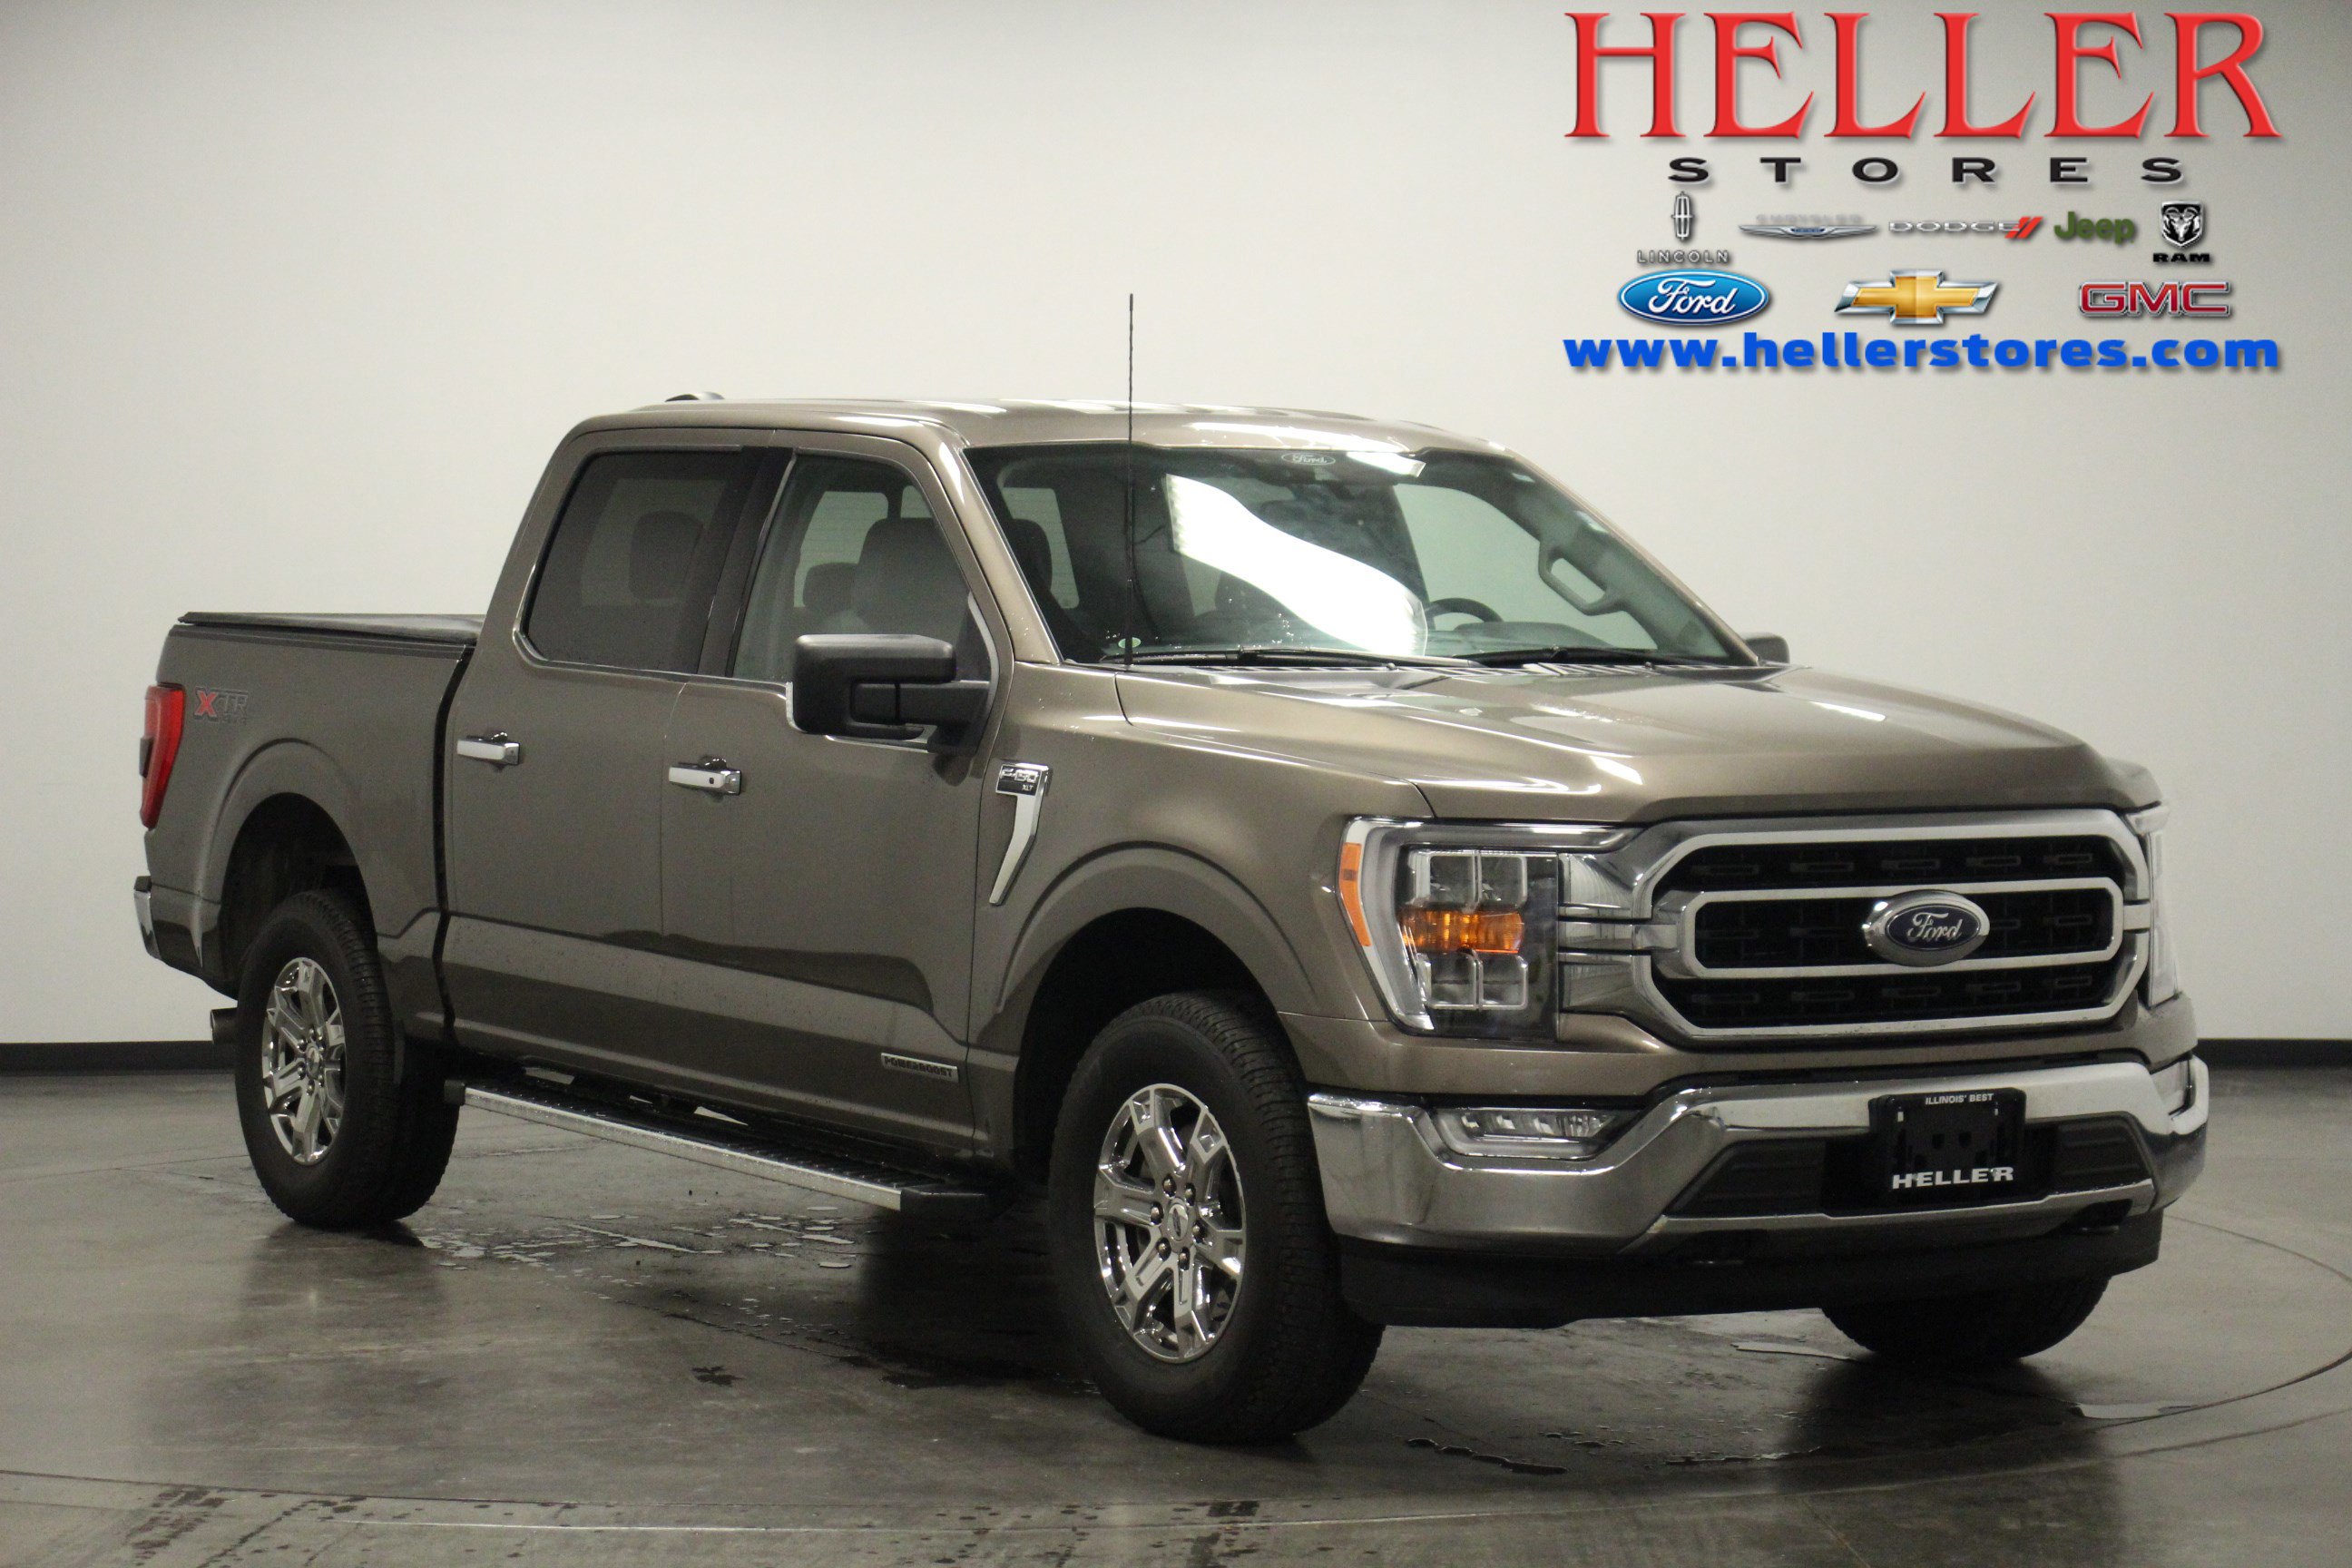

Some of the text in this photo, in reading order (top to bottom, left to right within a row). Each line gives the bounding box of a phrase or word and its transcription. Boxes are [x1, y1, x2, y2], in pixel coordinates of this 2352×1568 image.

[1292, 453, 1328, 464] Ford
[1022, 783, 1034, 792] XLT
[1906, 912, 1964, 943] Ford
[1925, 1093, 1994, 1105] ILLINOIS' BEST
[1892, 1166, 2014, 1190] HELLER
